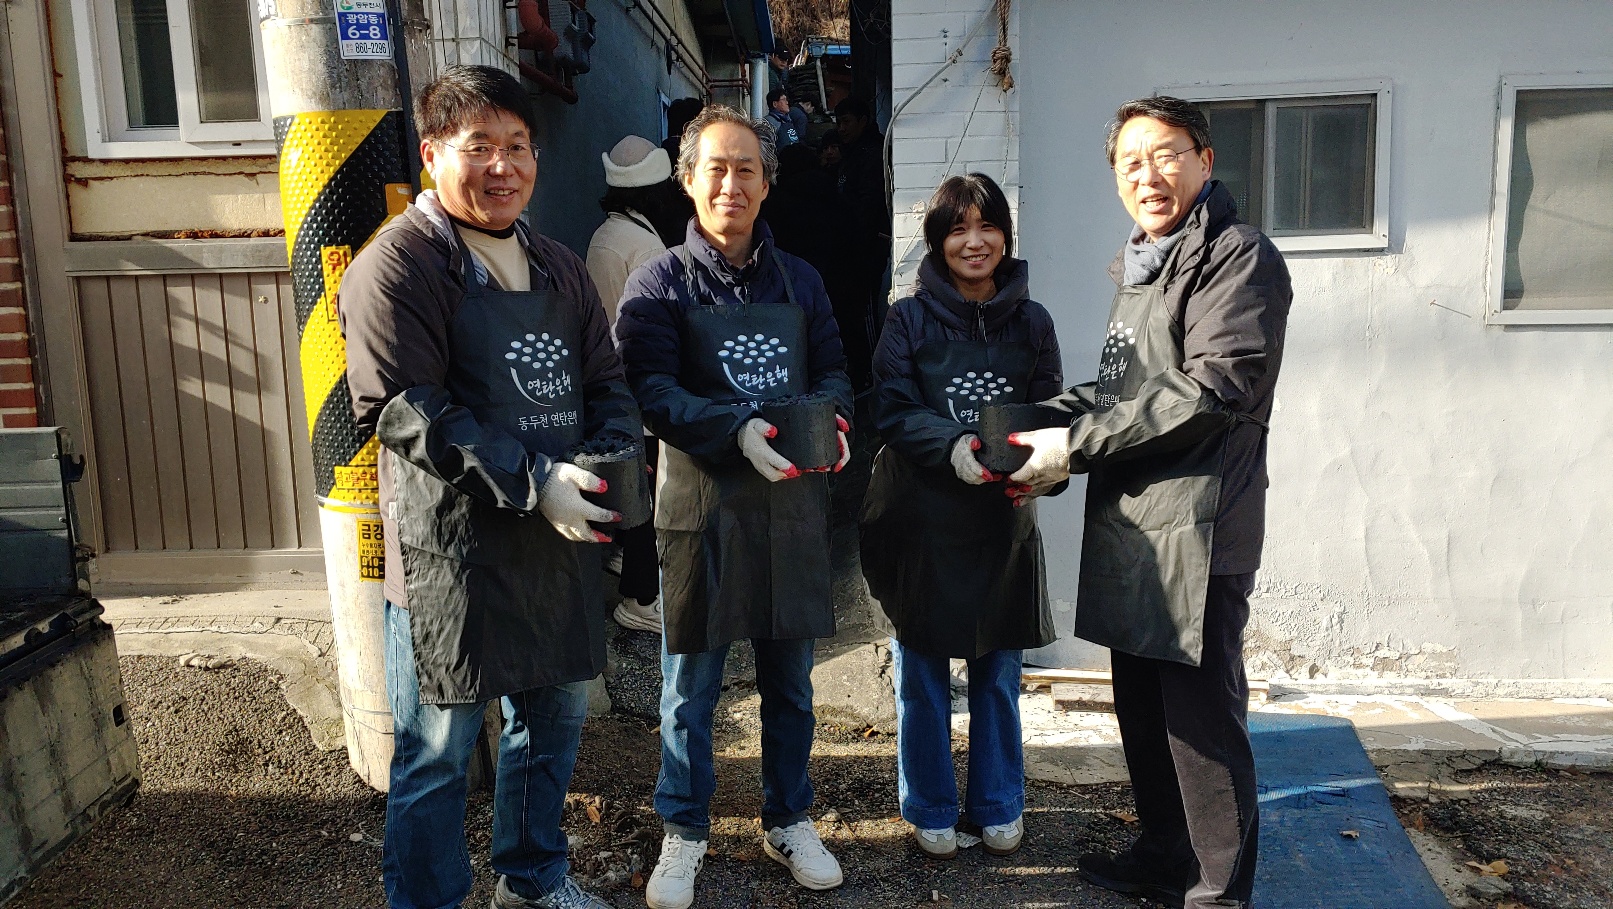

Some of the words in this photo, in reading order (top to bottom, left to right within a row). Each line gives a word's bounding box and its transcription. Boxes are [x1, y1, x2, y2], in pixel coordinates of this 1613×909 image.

[355, 1, 381, 9] 동두천시
[346, 13, 378, 24] 광암동
[347, 25, 381, 39] 6-8
[527, 369, 572, 399] 연탄은행
[737, 364, 789, 390] 연탄은행
[518, 413, 549, 431] 동두천
